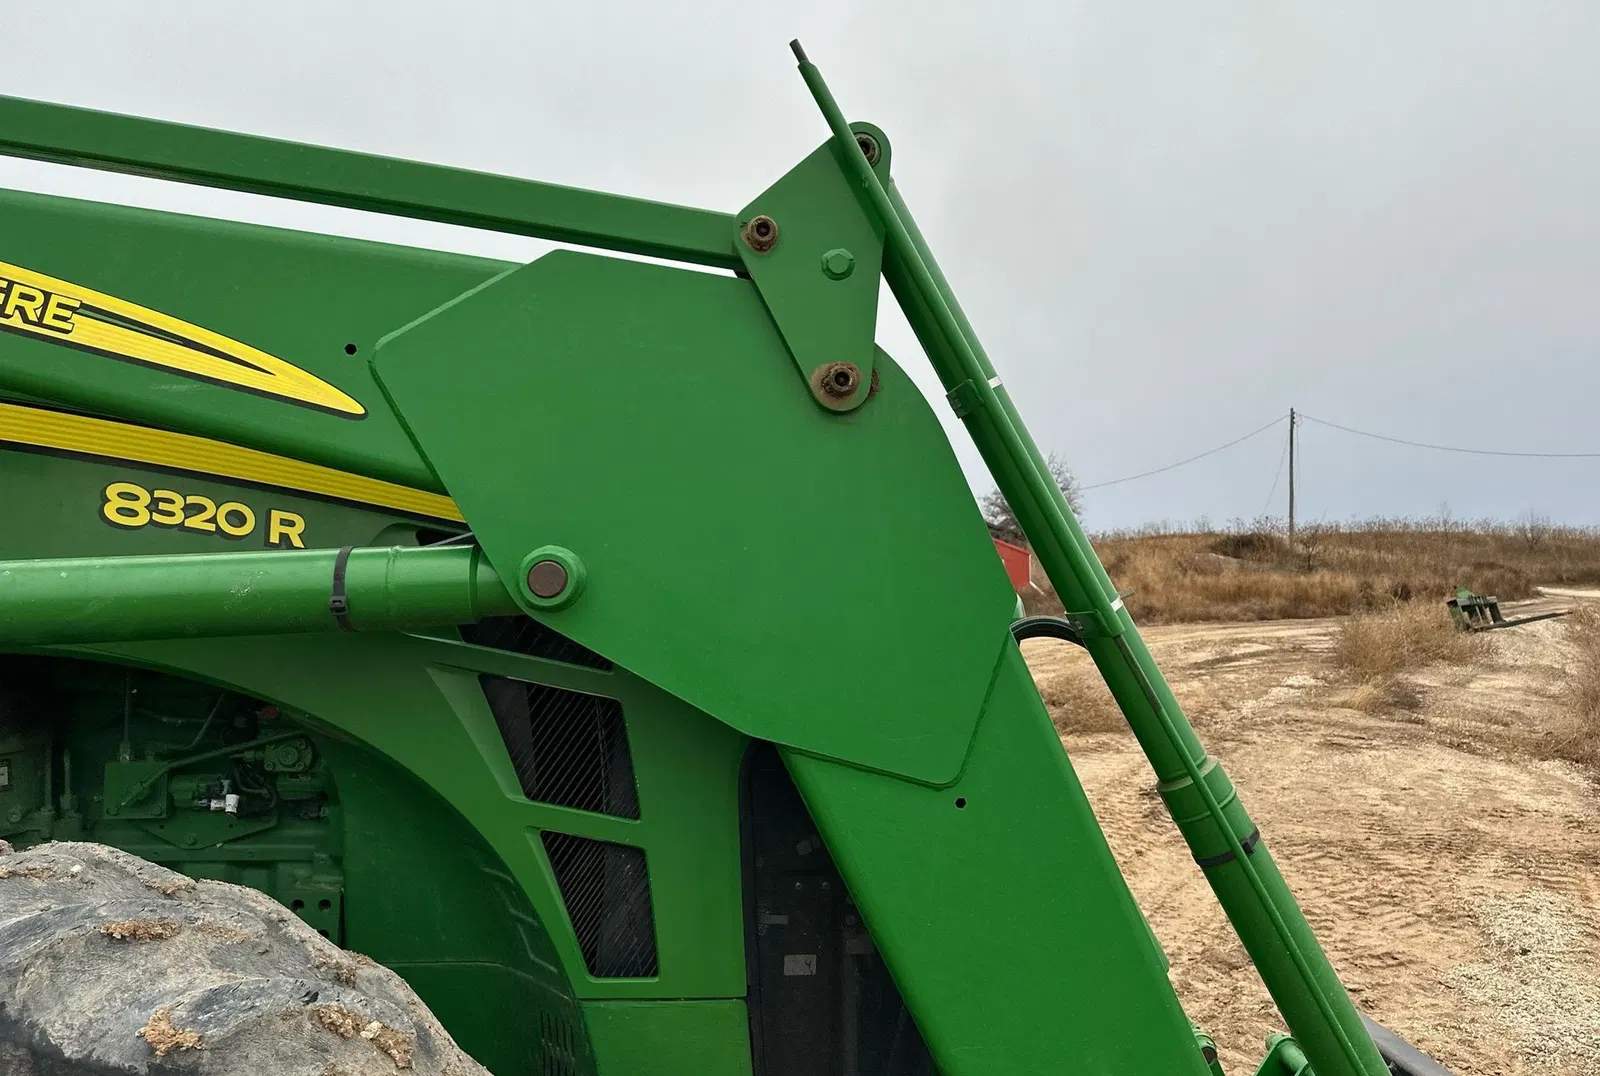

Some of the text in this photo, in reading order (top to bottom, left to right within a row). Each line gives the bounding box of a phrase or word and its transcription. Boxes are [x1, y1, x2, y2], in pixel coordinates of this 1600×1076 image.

[0, 278, 82, 334] RE
[102, 481, 306, 549] 8320 R
